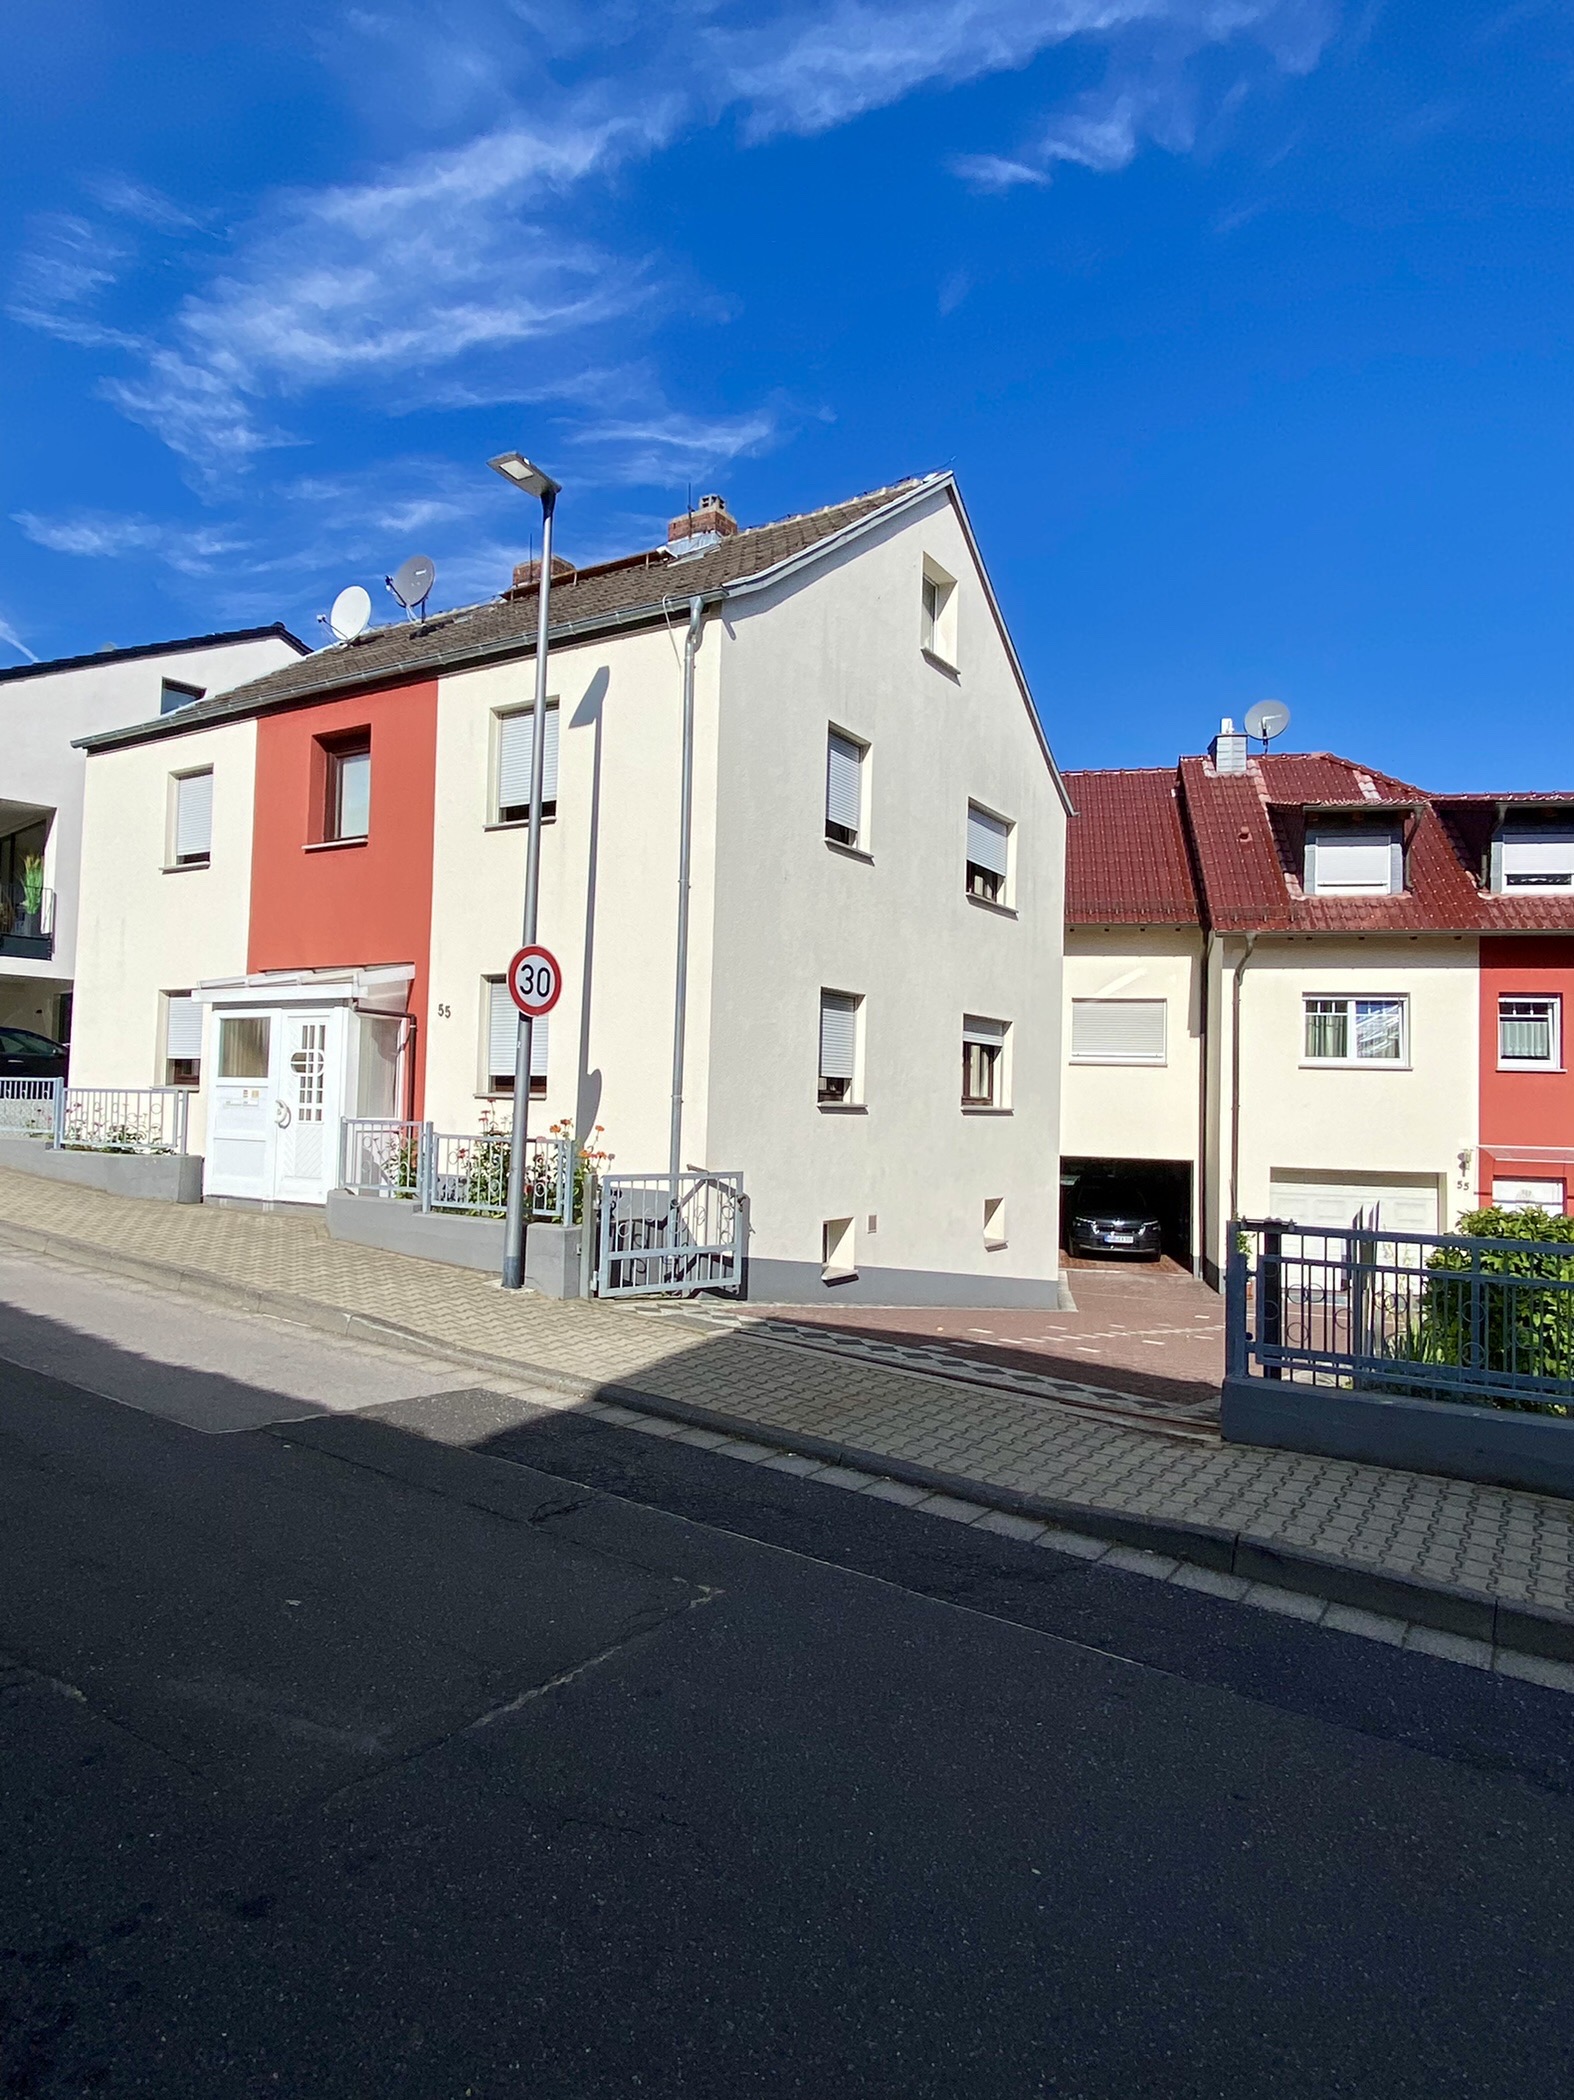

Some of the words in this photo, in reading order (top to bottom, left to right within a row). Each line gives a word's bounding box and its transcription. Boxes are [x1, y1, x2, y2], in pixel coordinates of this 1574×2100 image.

[519, 964, 551, 998] 30
[437, 1003, 452, 1019] 55
[1456, 1180, 1470, 1191] 55
